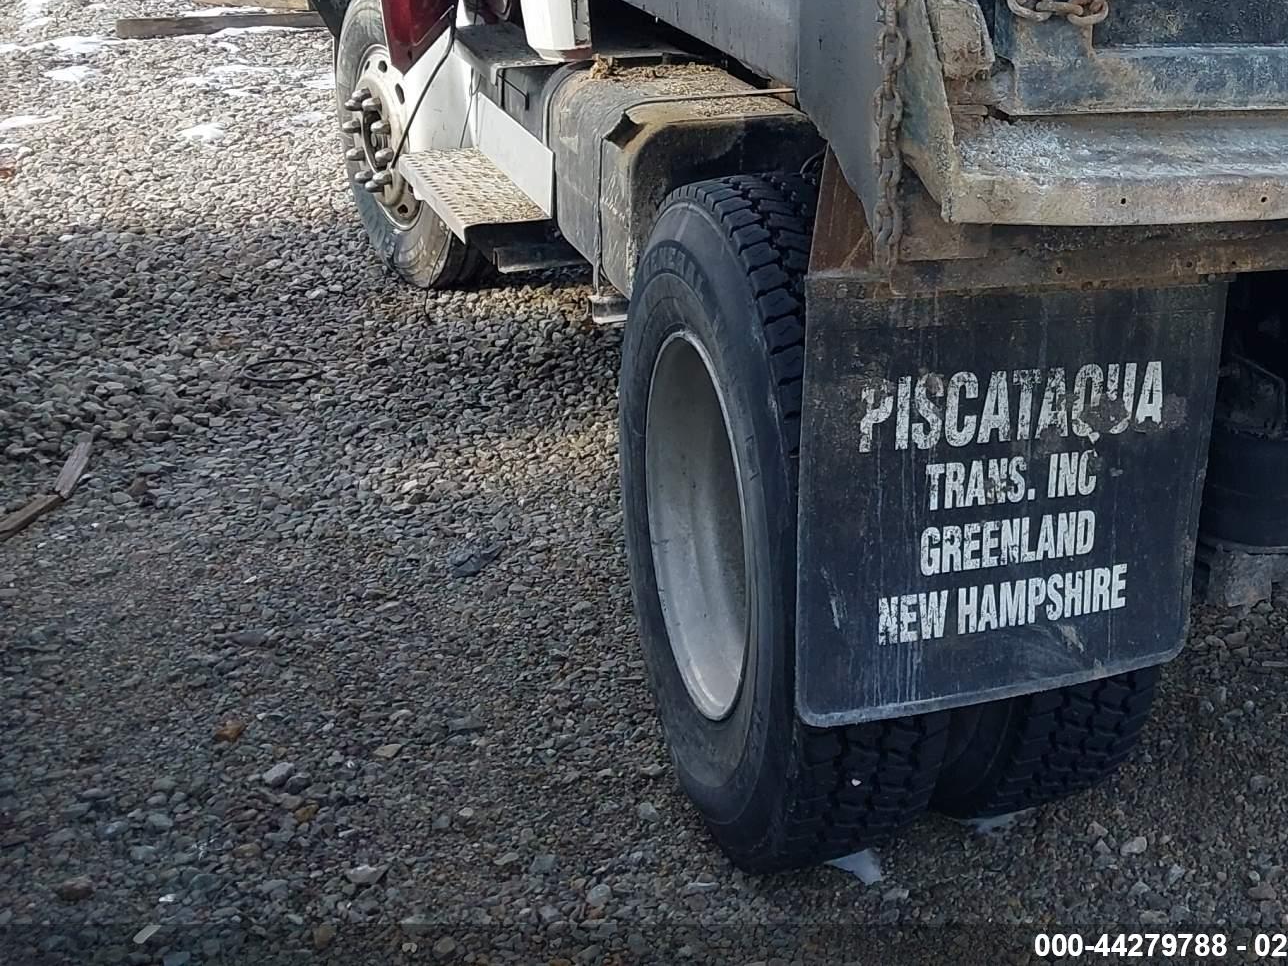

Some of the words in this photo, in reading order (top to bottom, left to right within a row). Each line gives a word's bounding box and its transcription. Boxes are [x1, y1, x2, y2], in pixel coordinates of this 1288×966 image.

[858, 360, 1163, 453] PISCATAQUA
[925, 455, 1035, 511] TRANS.
[1047, 449, 1098, 498] INC
[920, 510, 1095, 577] GREENLAND
[878, 591, 947, 646] NEW
[957, 563, 1128, 635] HAMPSHIRE
